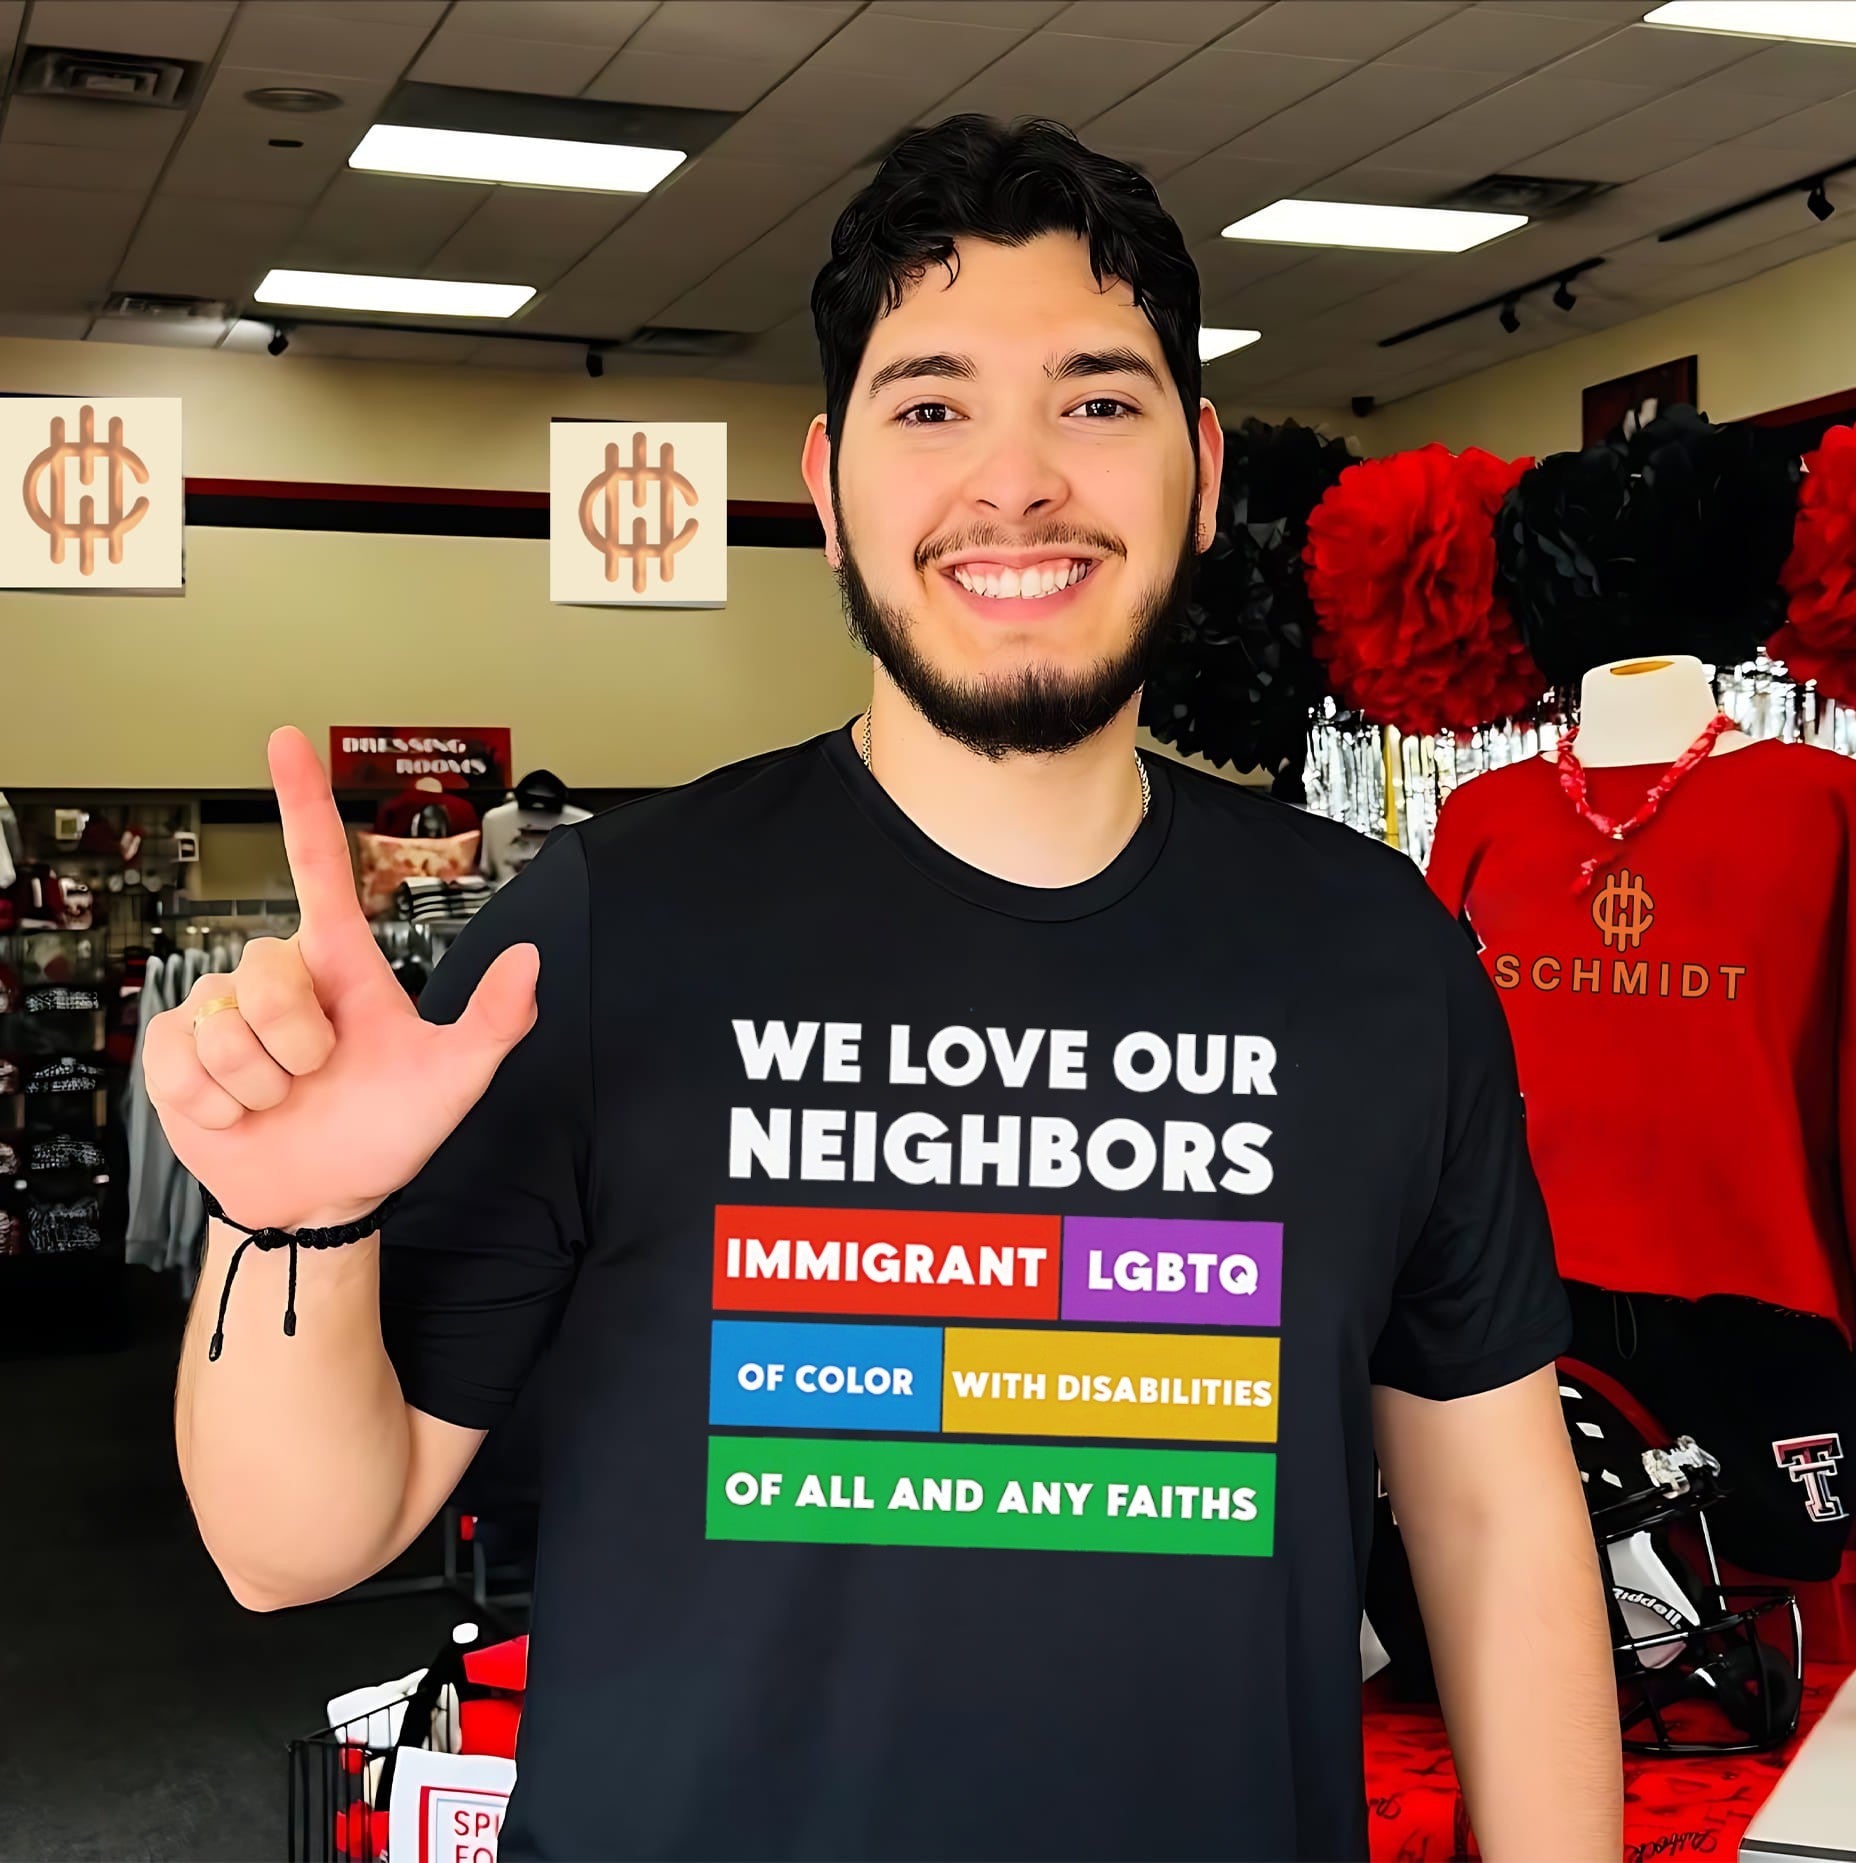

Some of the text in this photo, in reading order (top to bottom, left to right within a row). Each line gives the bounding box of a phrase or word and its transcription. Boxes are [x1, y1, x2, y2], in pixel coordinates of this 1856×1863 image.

[396, 758, 487, 774] ROOMS
[1494, 954, 1746, 1000] SCHMIDT
[732, 1019, 1278, 1096] WE LOVE OUR
[729, 1107, 1274, 1195] NEIGHBORS
[726, 1238, 1047, 1287] IMMIGRANT
[1088, 1250, 1259, 1296] LGBTQ
[737, 1362, 913, 1395] OF COLOR
[952, 1371, 1272, 1407] WITH DISABILITIES
[725, 1472, 1257, 1521] OF ALL AND ANY FAITHS
